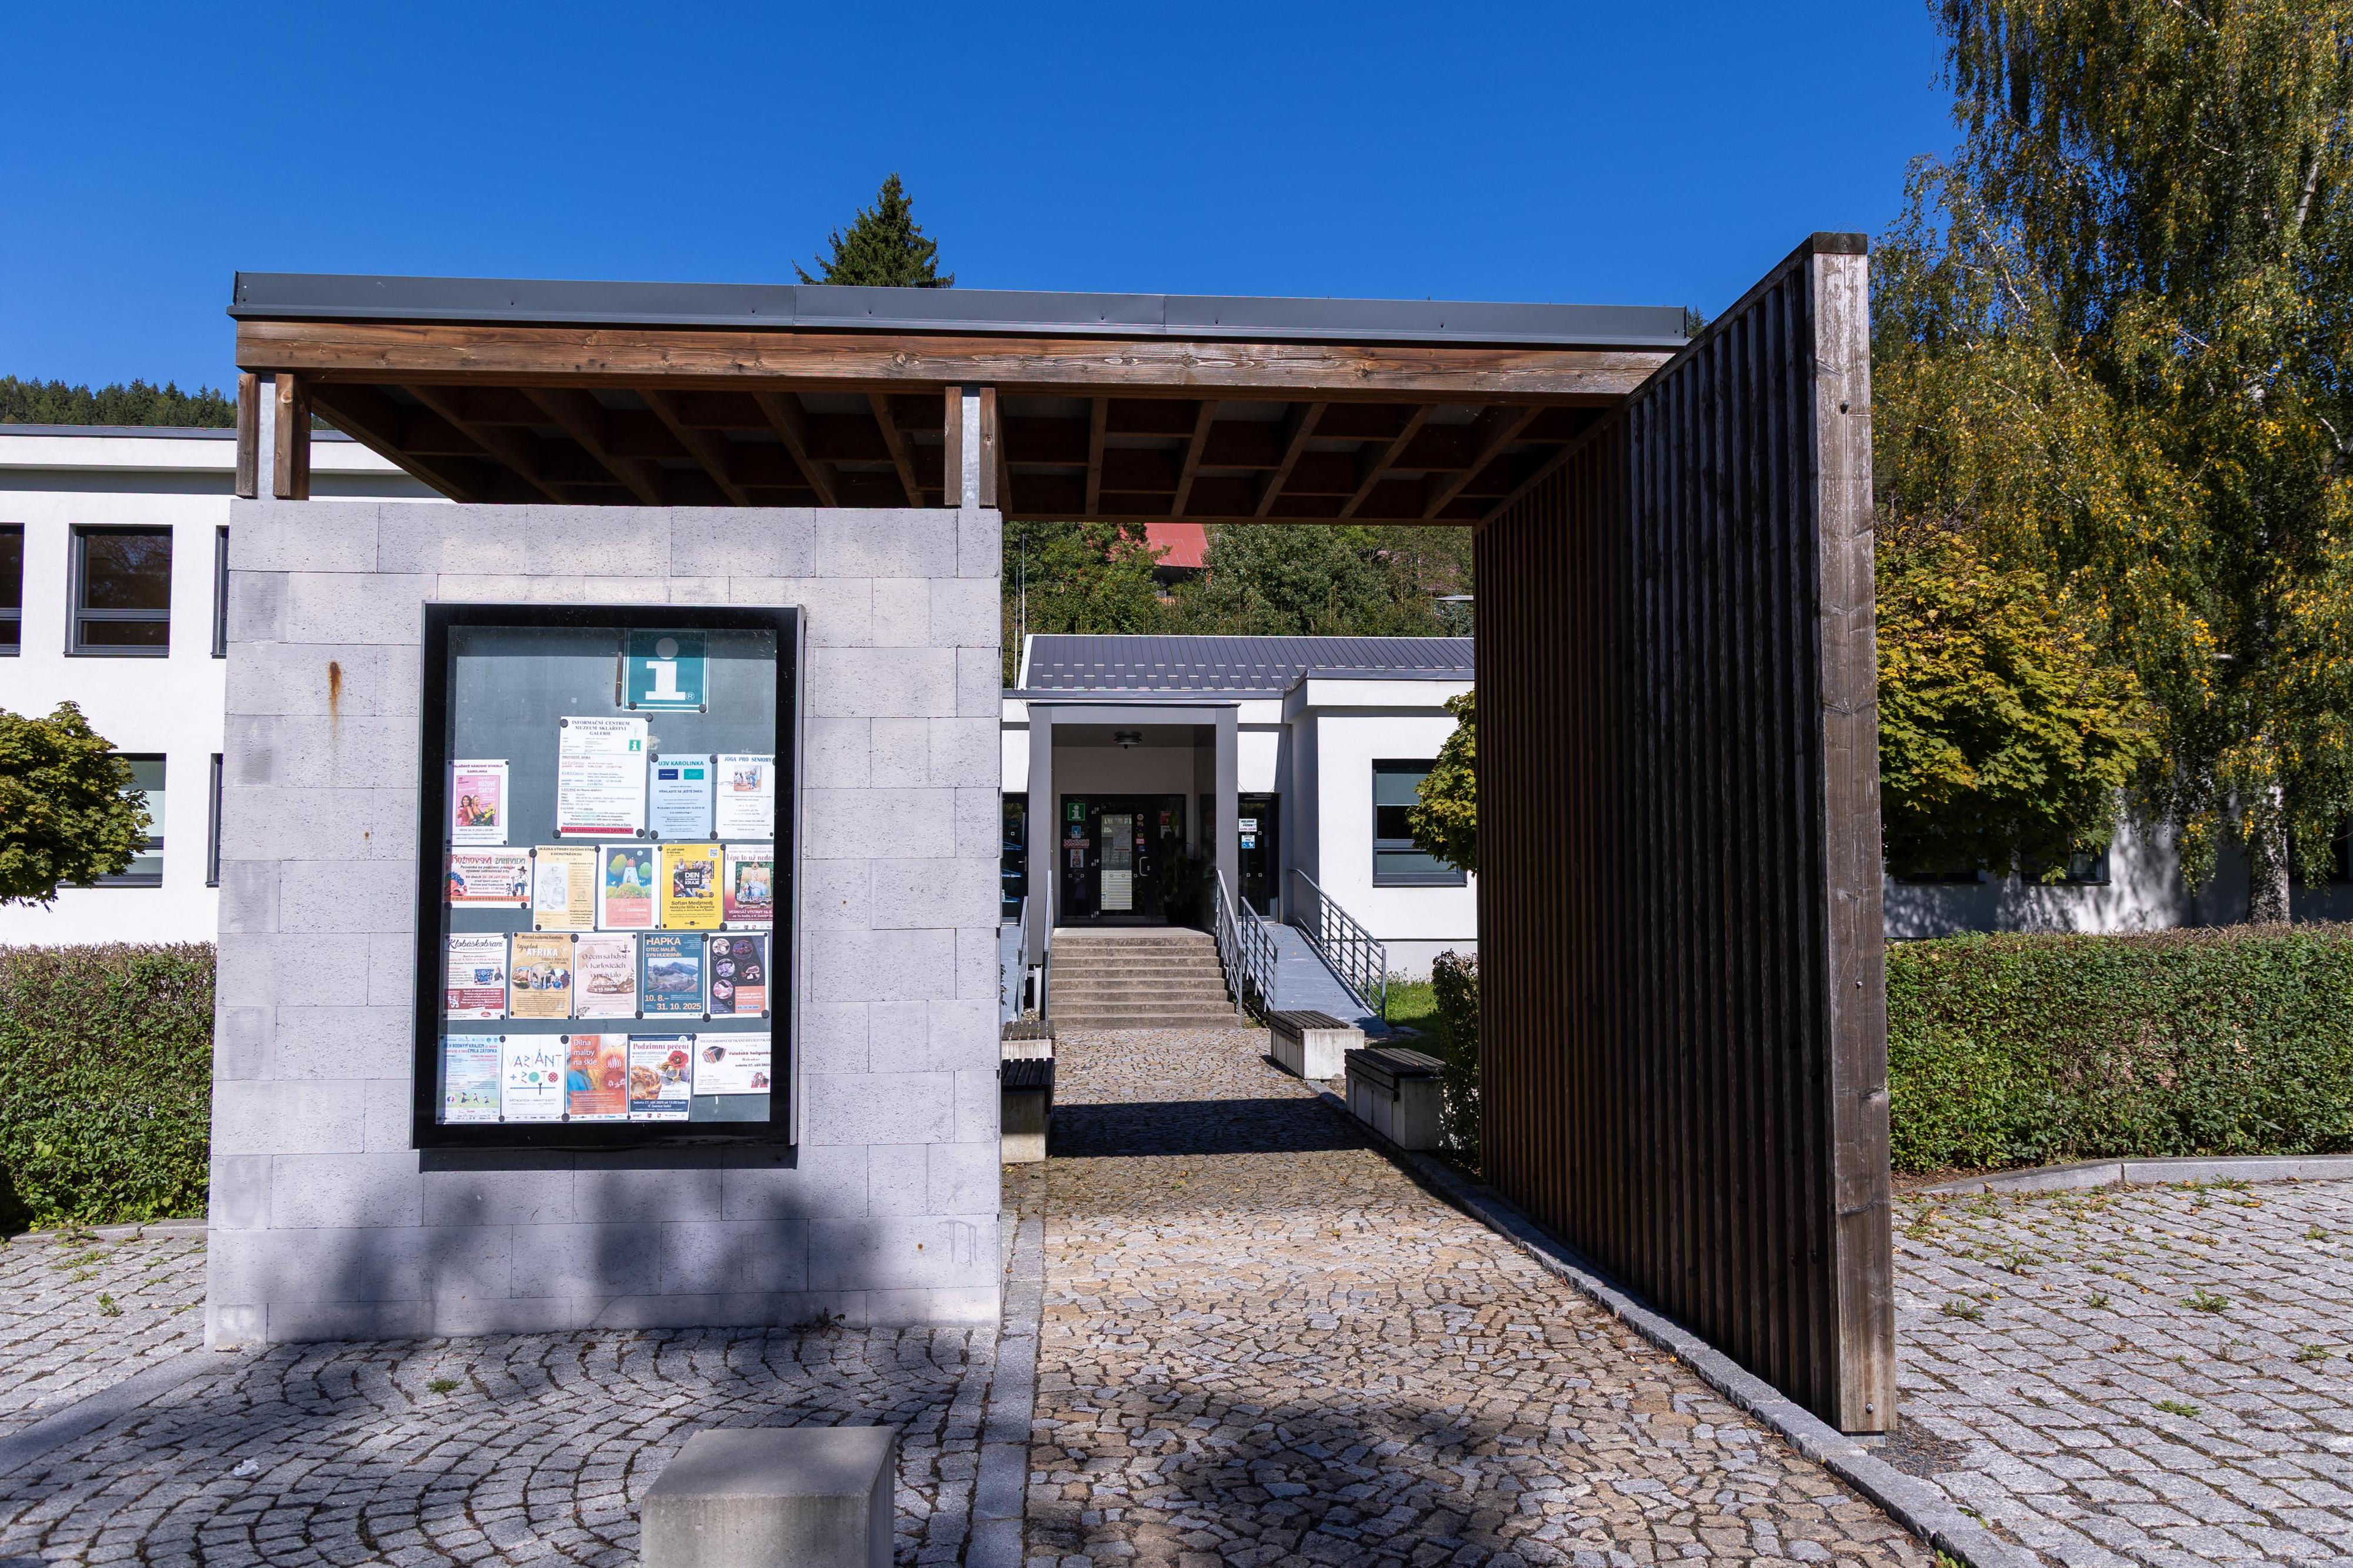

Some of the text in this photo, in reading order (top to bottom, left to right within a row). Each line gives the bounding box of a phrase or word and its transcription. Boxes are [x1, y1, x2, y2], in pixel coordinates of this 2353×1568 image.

[452, 854, 492, 864] ROŽNOVSKÁ
[726, 853, 740, 862] Lépe
[448, 939, 504, 949] Klobáskobraní
[646, 937, 681, 945] HAPKA
[526, 948, 559, 956] AFRIKA
